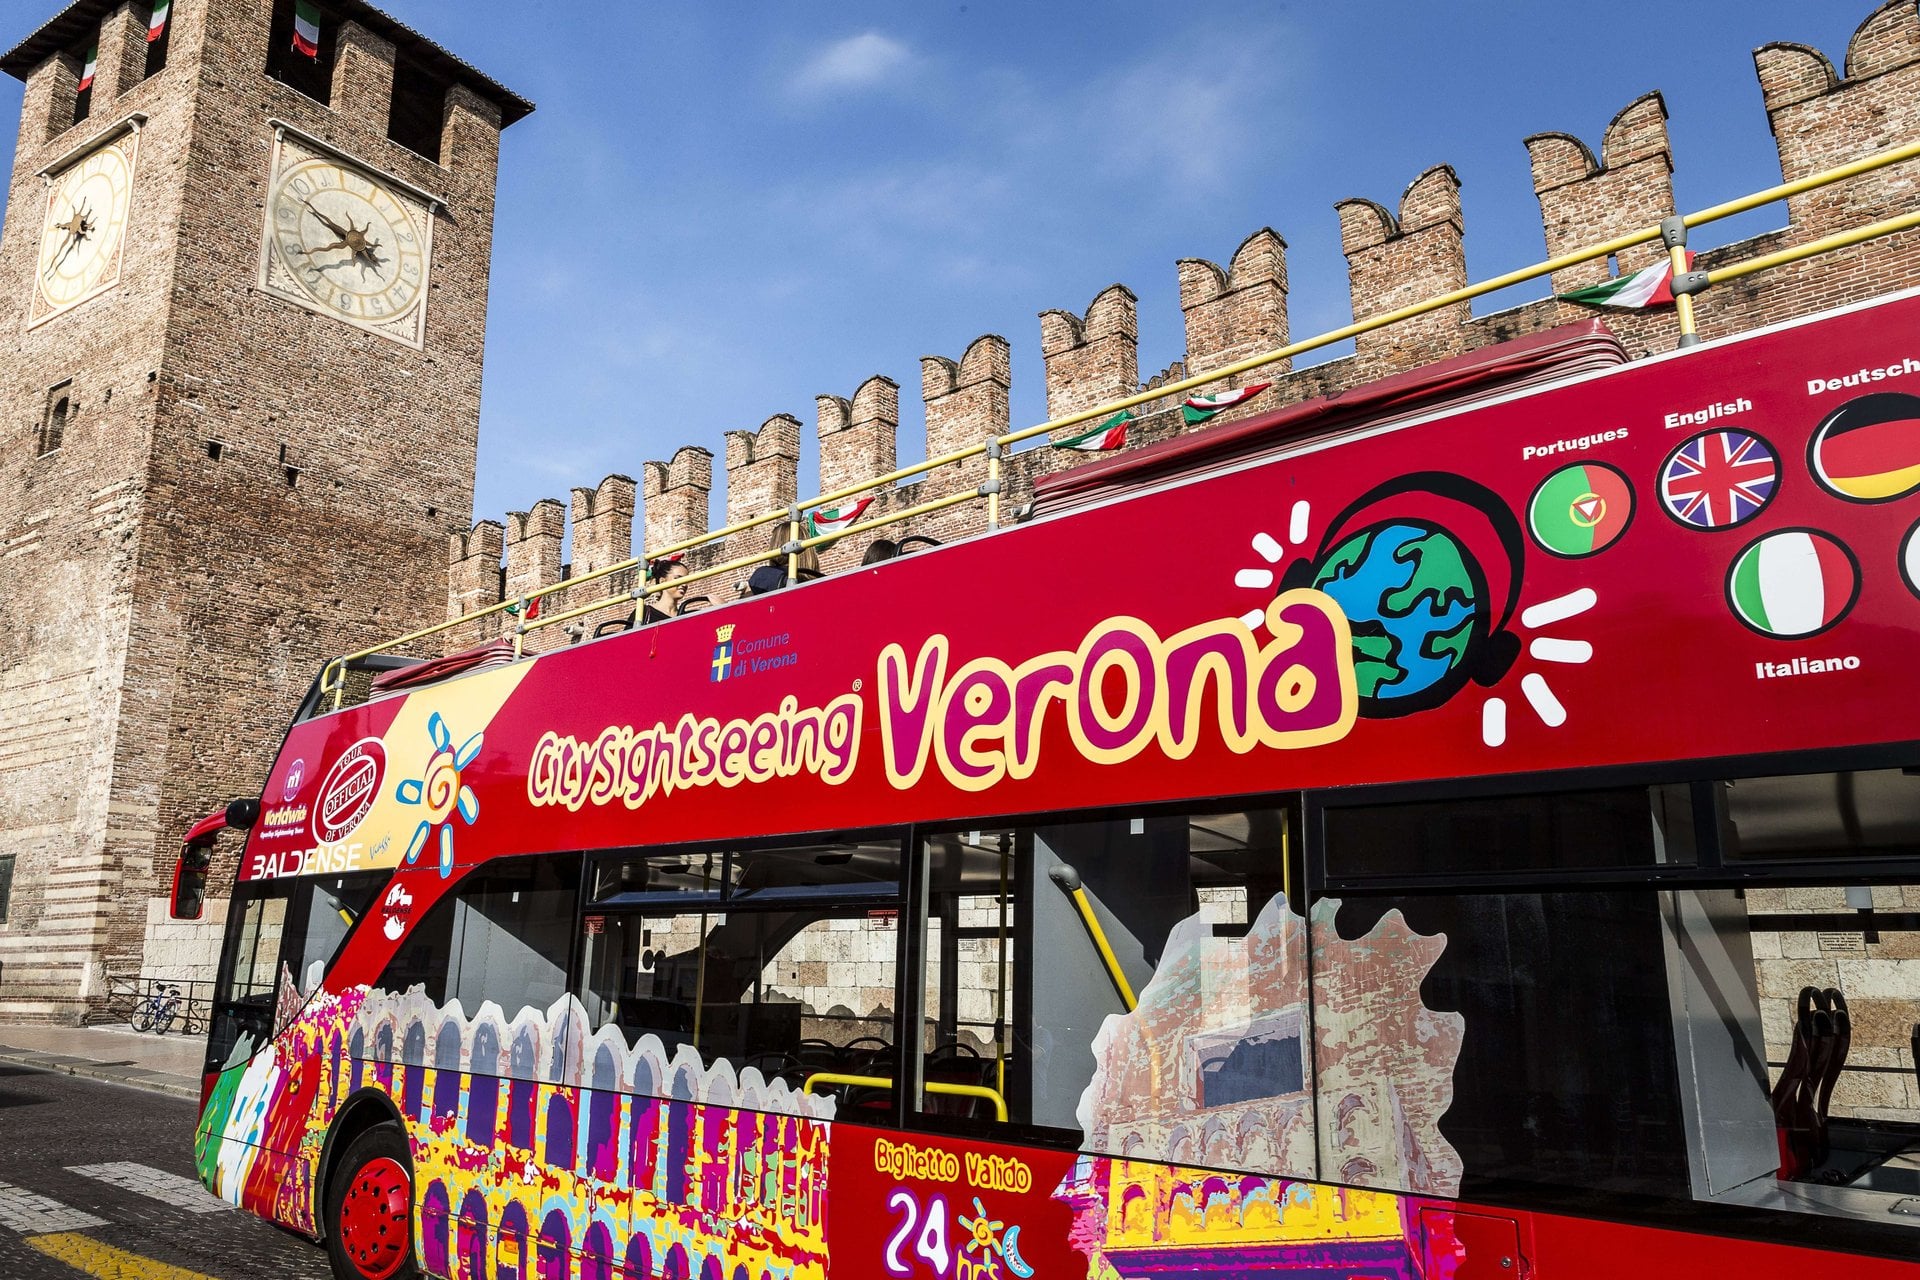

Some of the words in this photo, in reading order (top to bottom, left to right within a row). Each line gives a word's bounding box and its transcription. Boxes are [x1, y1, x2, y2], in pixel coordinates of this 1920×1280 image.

[289, 178, 311, 200] 10
[397, 231, 413, 243] 2
[1807, 358, 1920, 396] Deutsch
[1664, 397, 1752, 429] English
[1522, 425, 1629, 460] Portugues
[736, 632, 790, 655] Comune
[734, 659, 747, 677] di
[750, 652, 798, 673] Verona
[1755, 654, 1861, 679] Italiano
[877, 588, 1359, 791] Verona
[340, 746, 363, 770] TOUR
[326, 768, 373, 815] OFFICIAL
[264, 804, 308, 826] Worldwide
[326, 829, 337, 842] OF
[339, 801, 371, 838] VERONA
[250, 843, 363, 880] BALDENSE
[875, 1138, 960, 1182] Biglietto
[965, 1152, 1032, 1193] Valido
[885, 1189, 950, 1278] 24
